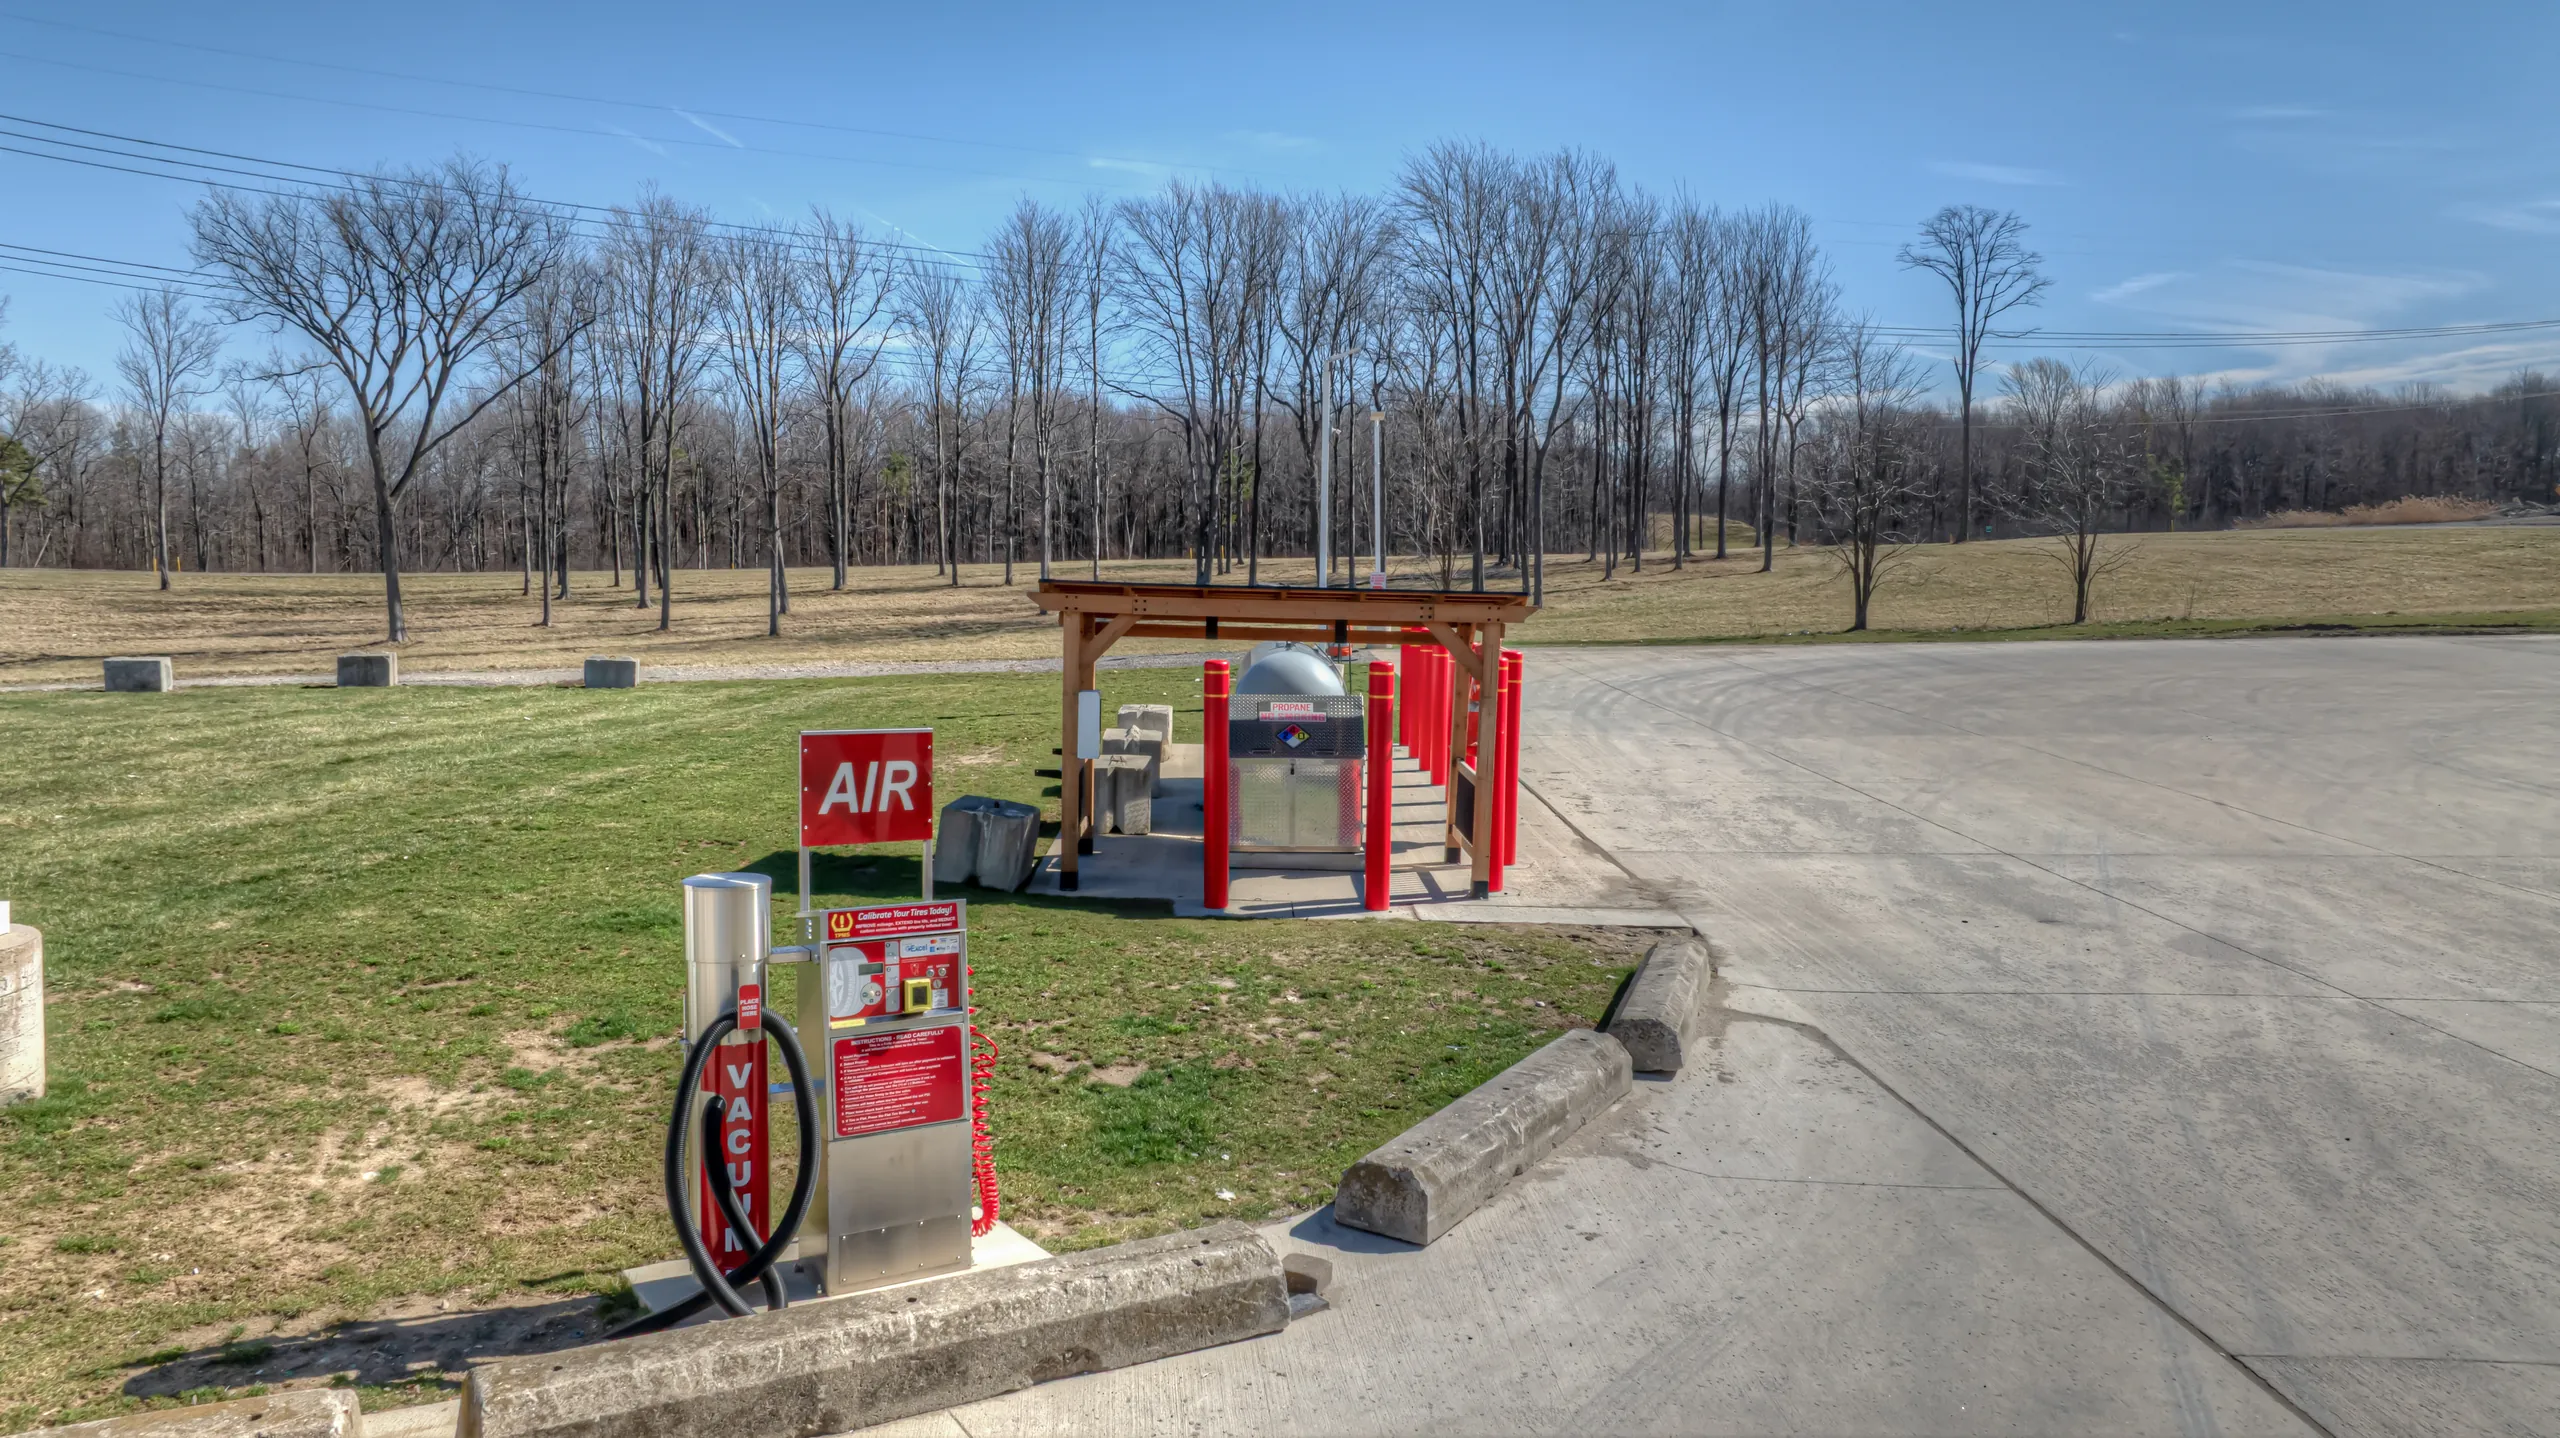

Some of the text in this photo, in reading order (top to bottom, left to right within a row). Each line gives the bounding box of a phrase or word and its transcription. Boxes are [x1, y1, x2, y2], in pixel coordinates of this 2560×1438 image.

[1272, 703, 1312, 711] PROPANE
[1278, 713, 1325, 721] SMOKING
[818, 760, 918, 815] AIR
[858, 905, 953, 921] Calibrate Your Tires Today!
[851, 1036, 892, 1045] INSTRUCTIONS
[912, 1030, 944, 1038] CAREFULLY
